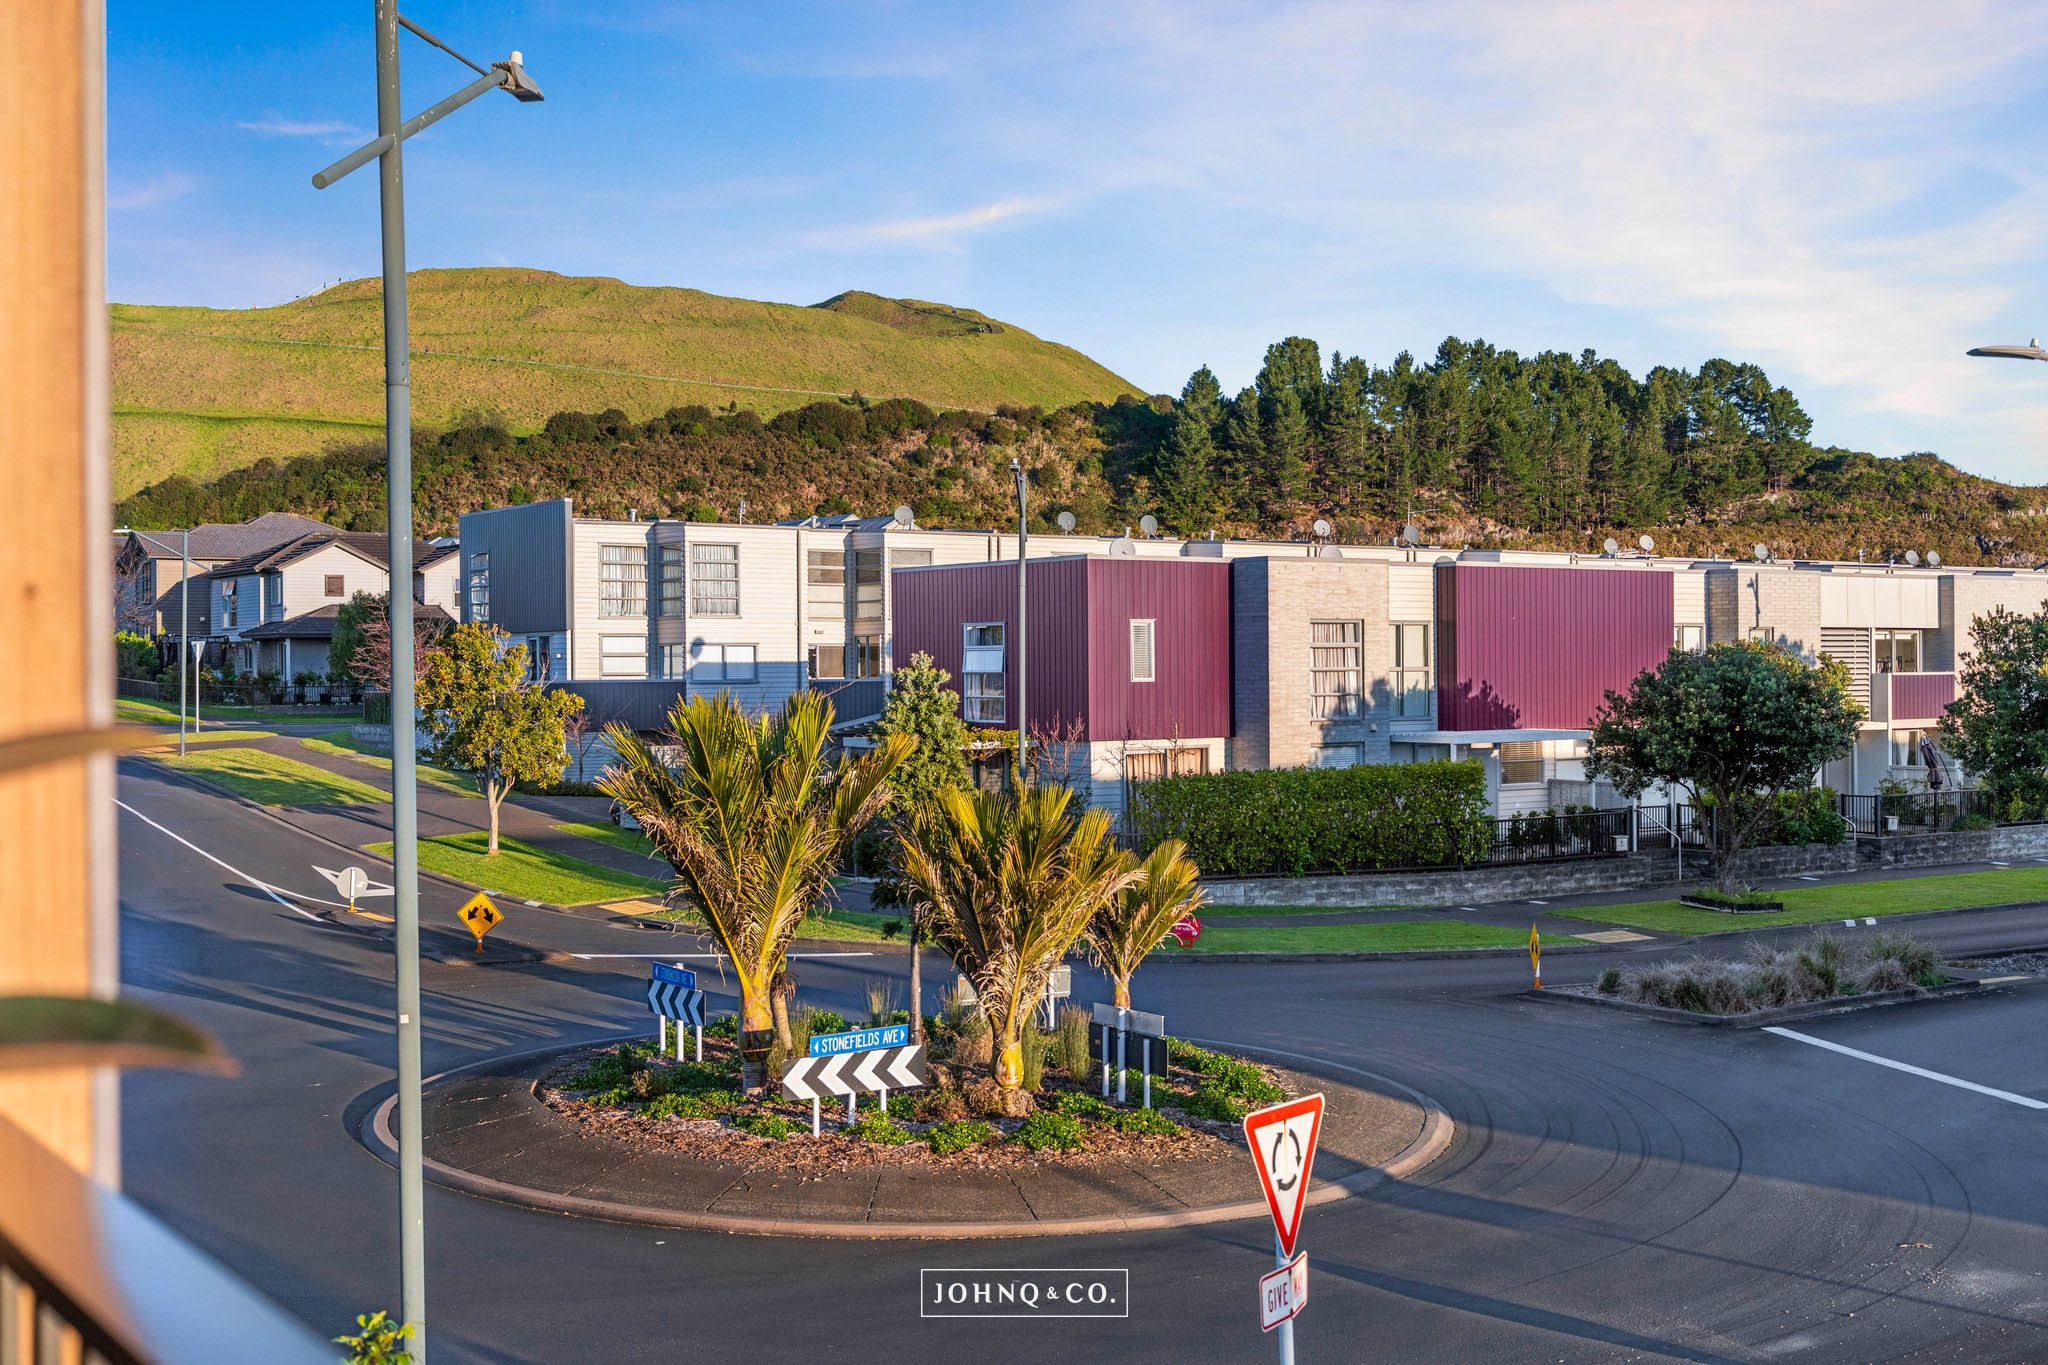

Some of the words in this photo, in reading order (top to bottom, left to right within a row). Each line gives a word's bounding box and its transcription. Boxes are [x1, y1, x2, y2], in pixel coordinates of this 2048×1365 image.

[821, 1031, 880, 1053] STONEFIELDS
[882, 1029, 899, 1045] AVE
[1268, 1282, 1288, 1313] GIVE
